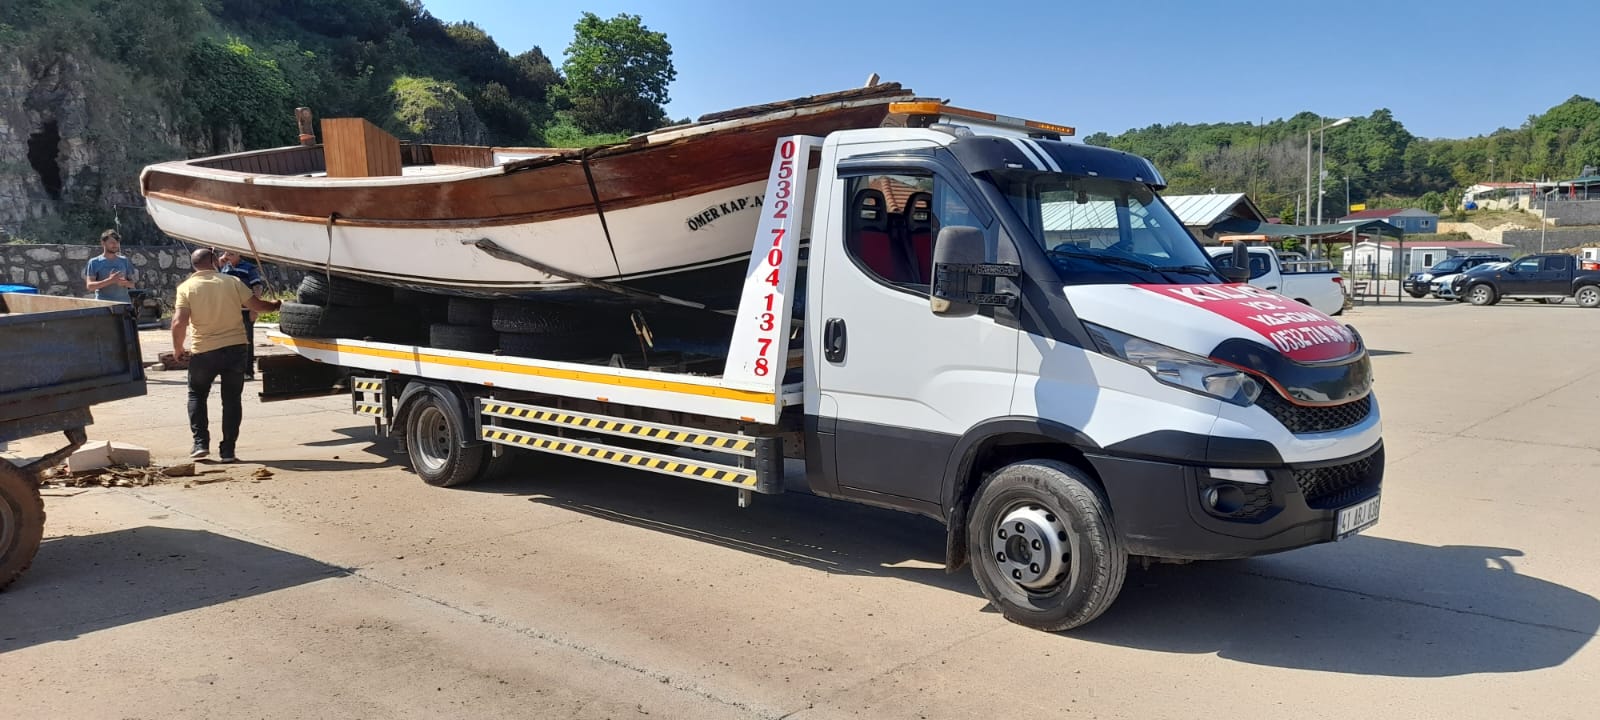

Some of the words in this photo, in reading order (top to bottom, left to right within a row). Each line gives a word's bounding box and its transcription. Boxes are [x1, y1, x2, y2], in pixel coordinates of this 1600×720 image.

[773, 140, 795, 219] 0532
[720, 195, 765, 215] KAPA
[765, 228, 786, 287] 704
[759, 293, 775, 332] 13
[1239, 301, 1286, 310] YOL
[1247, 311, 1328, 326] YARDIM
[1270, 328, 1313, 353] 0532
[754, 338, 772, 377] 78
